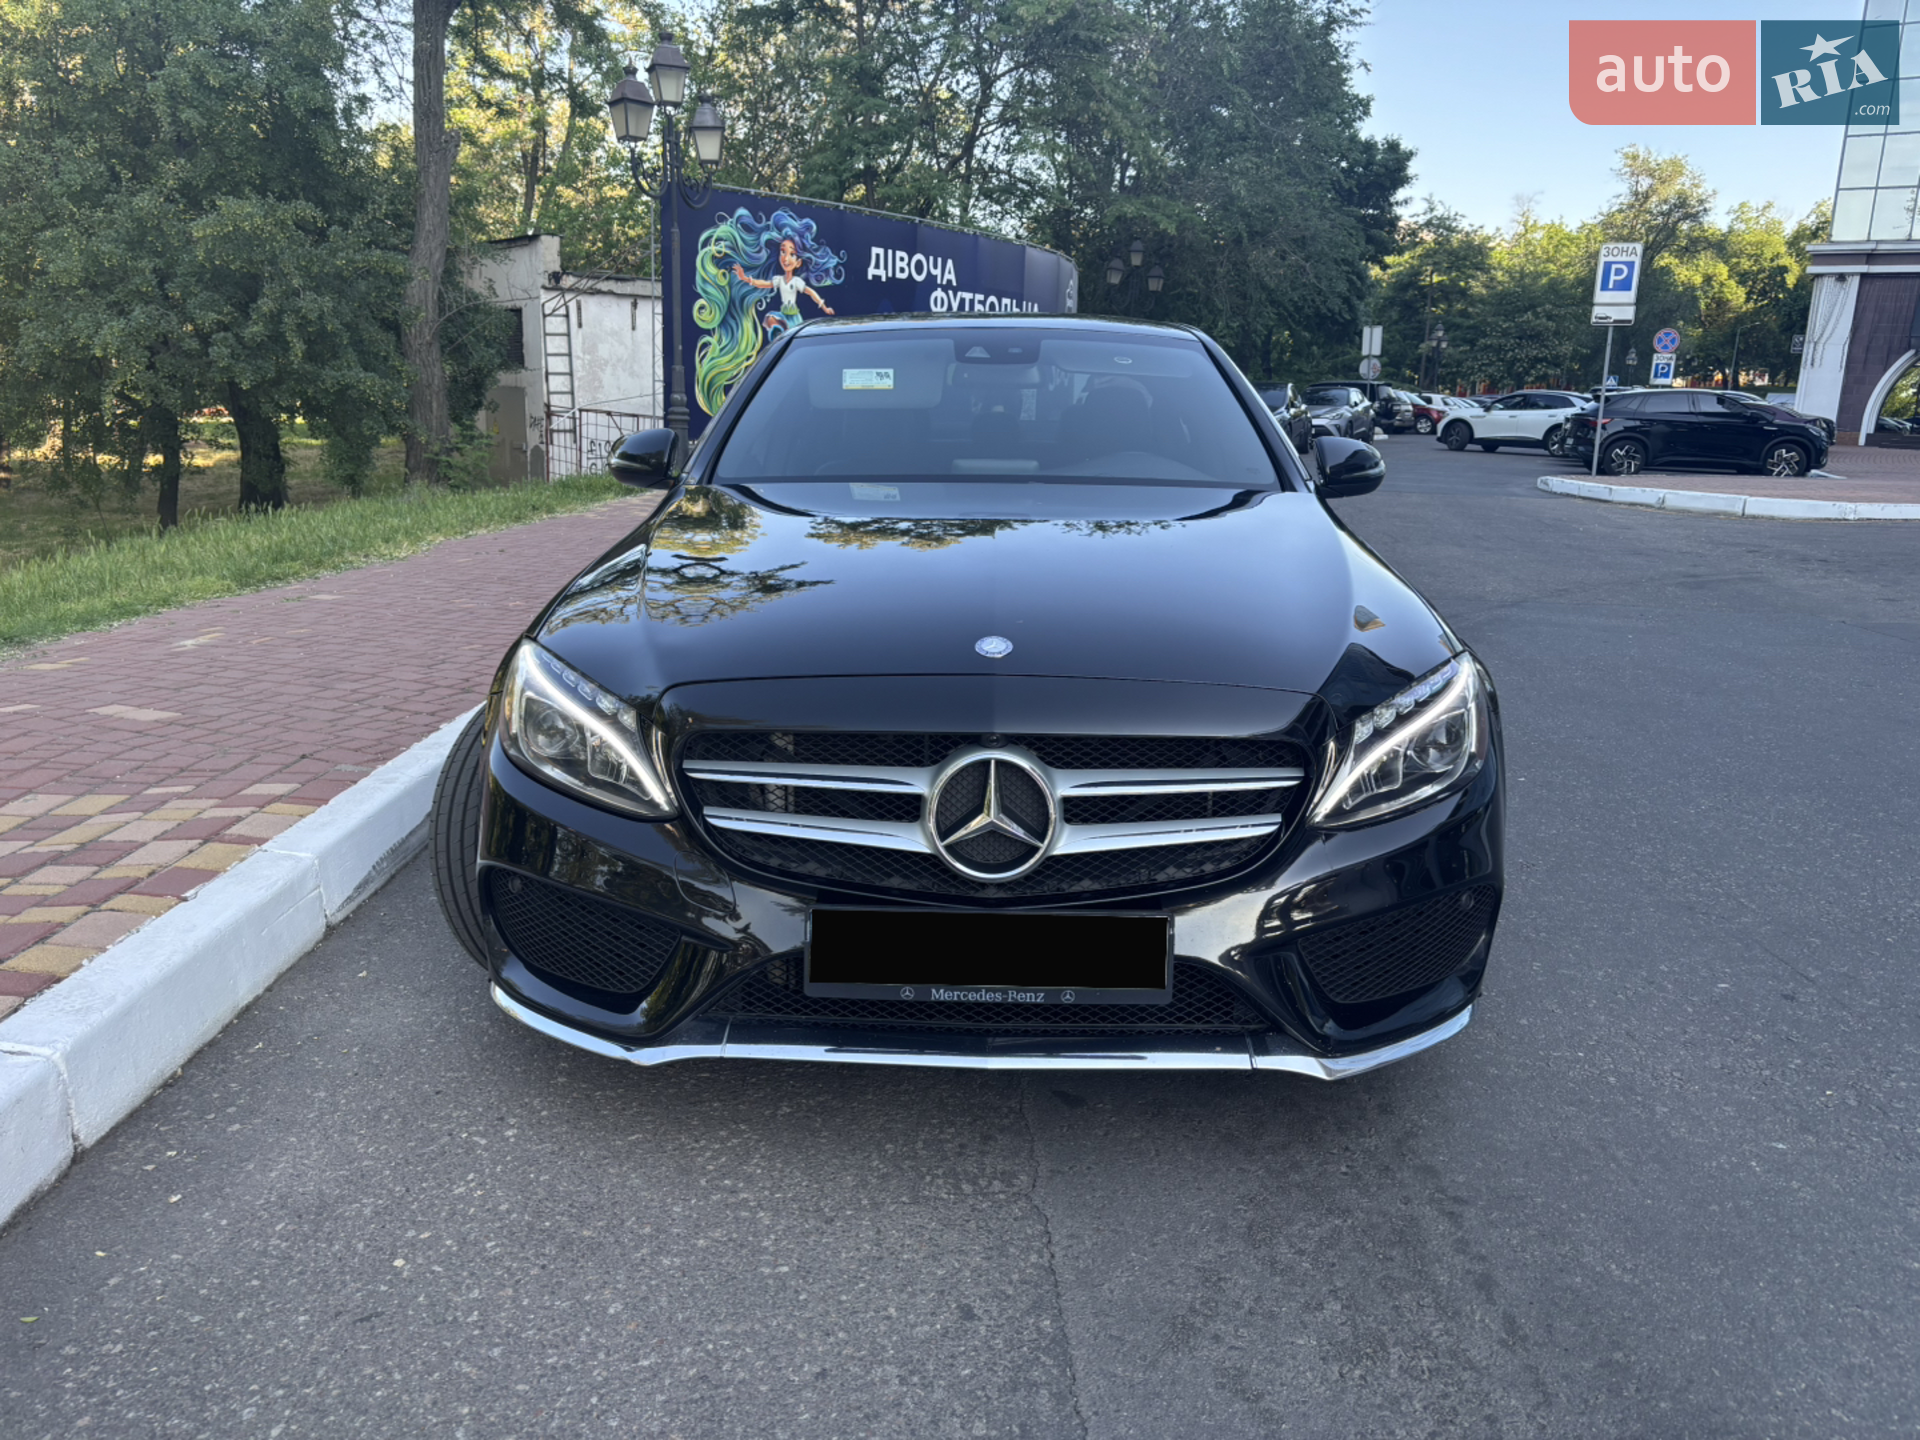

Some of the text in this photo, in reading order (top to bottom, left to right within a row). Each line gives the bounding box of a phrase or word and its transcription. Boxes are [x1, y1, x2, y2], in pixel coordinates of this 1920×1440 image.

[1603, 246, 1638, 258] ЗОНА
[867, 246, 957, 287] ДІВОЧА
[1608, 263, 1629, 289] P
[930, 988, 1045, 1003] Mercedes-Benz
